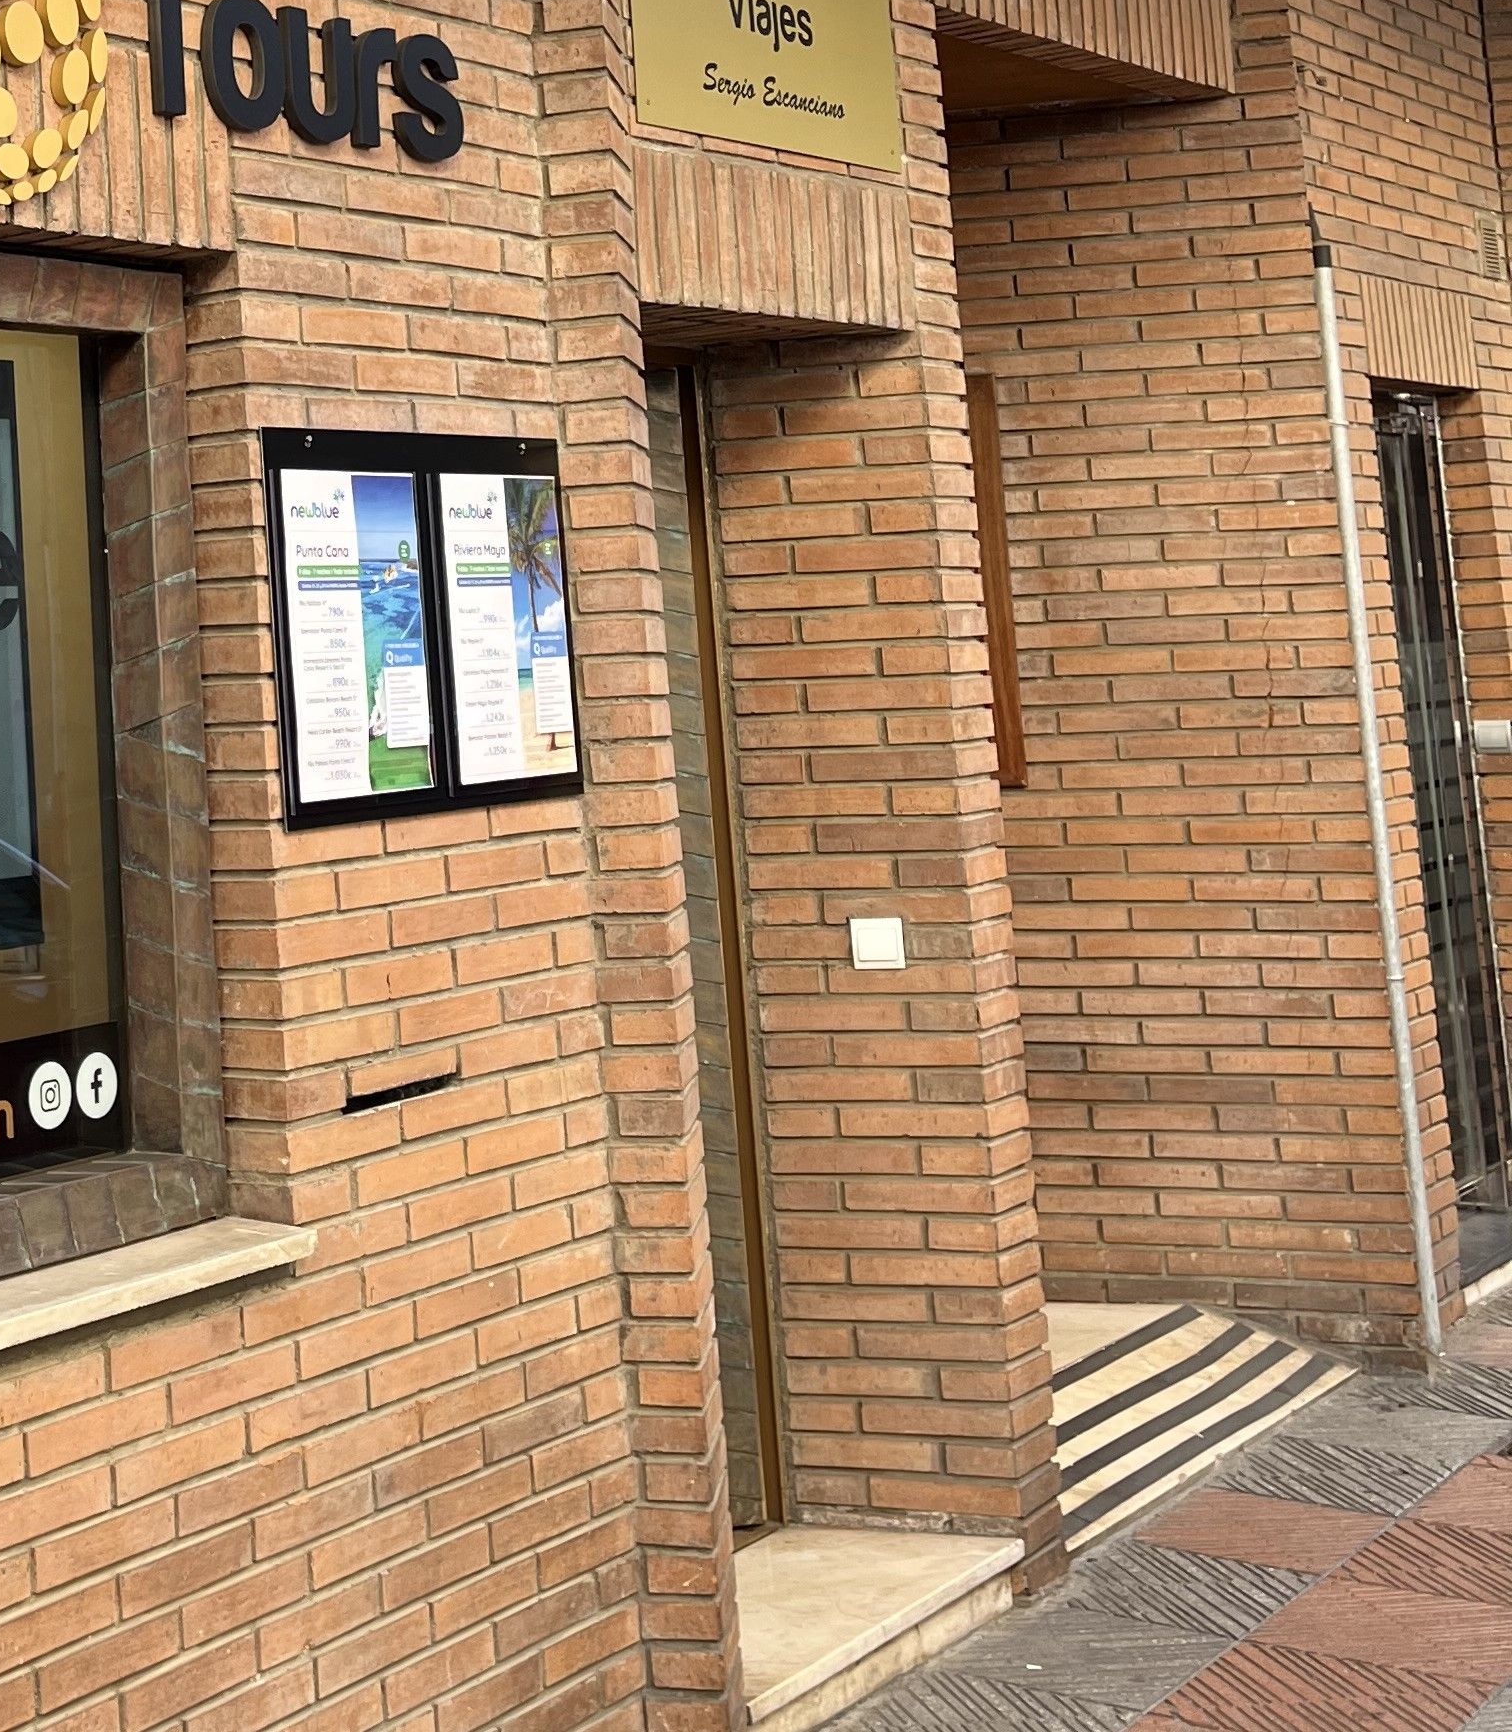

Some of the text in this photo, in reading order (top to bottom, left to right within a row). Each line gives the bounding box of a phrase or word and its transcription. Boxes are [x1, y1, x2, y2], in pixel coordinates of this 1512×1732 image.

[702, 62, 846, 120] Sergio Escanciano
[290, 501, 340, 519] newblue
[448, 503, 493, 520] newblue
[296, 544, 349, 558] Punta Cana
[453, 543, 506, 558] Riviera Maya
